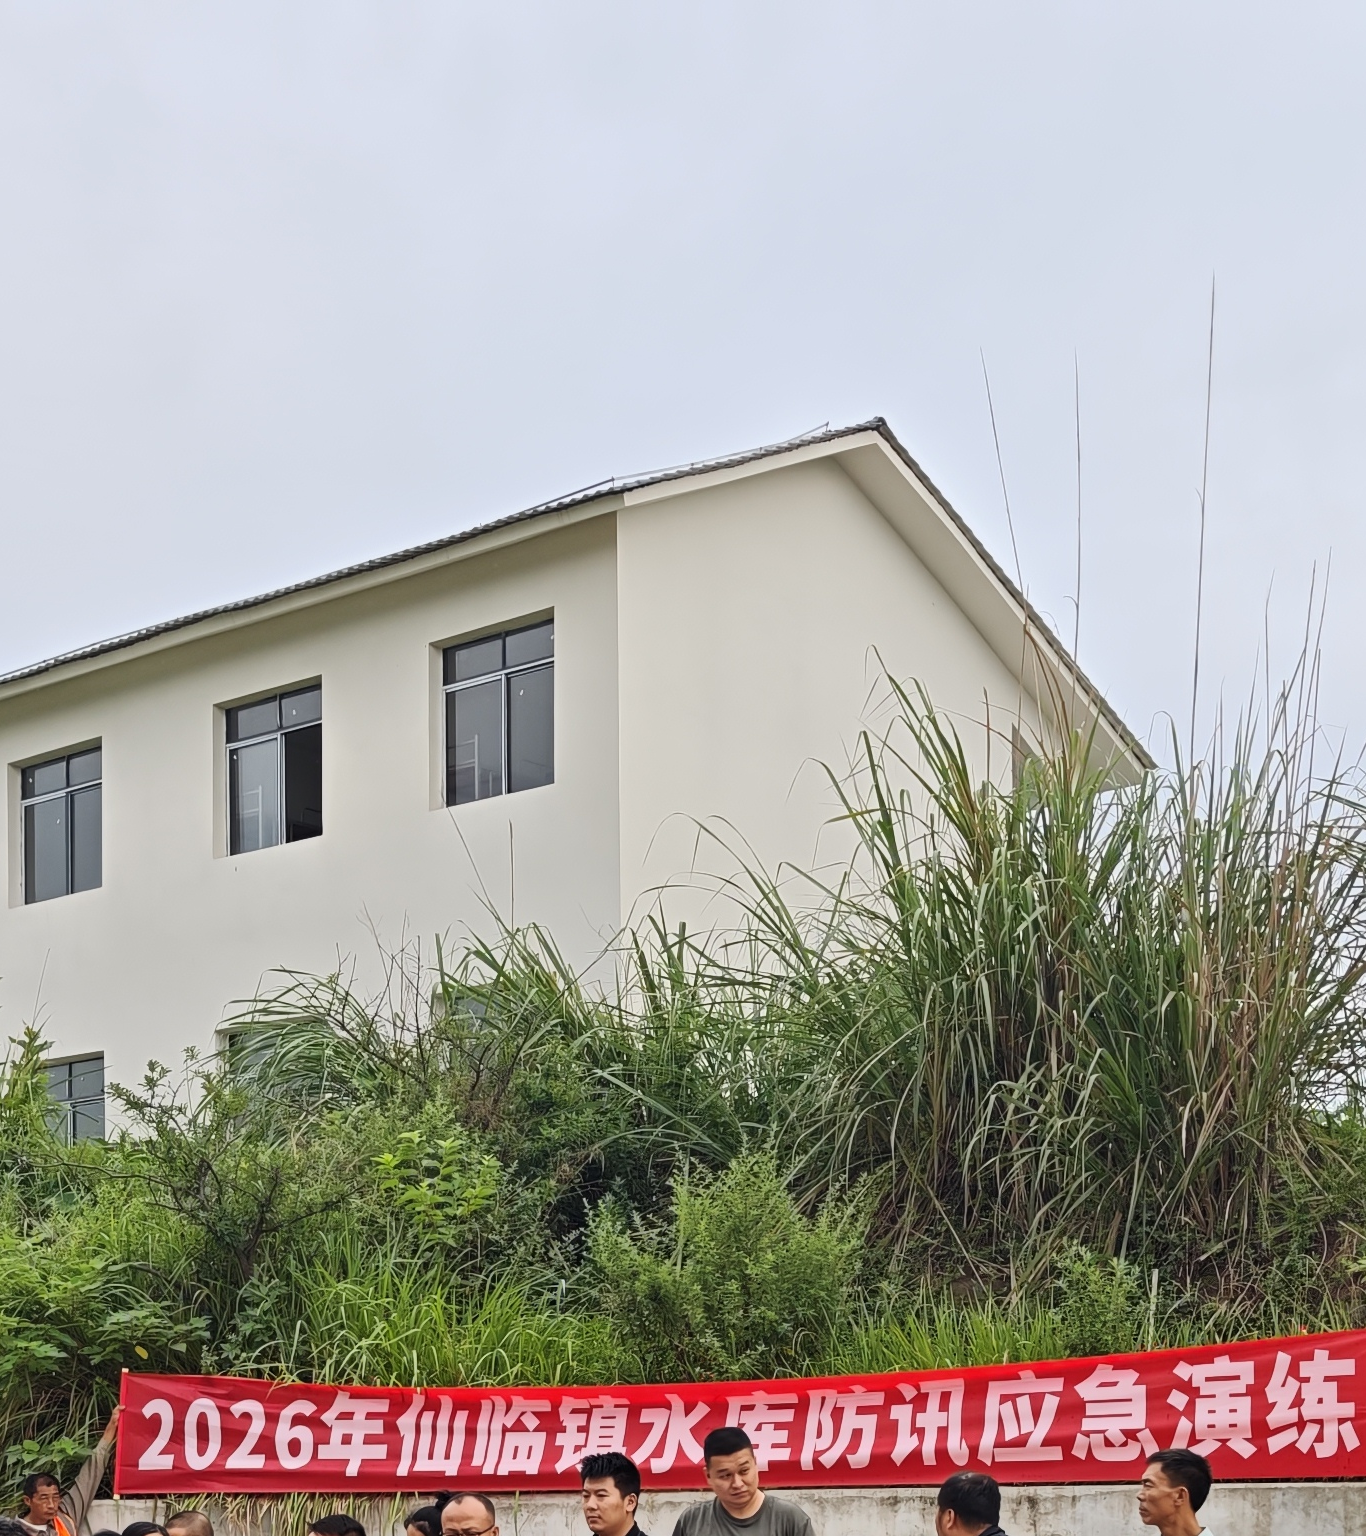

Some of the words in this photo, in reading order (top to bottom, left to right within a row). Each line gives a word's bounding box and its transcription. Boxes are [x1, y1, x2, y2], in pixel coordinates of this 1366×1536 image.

[137, 1348, 1362, 1477] 2026年仙临镇水库防讯应急演练
